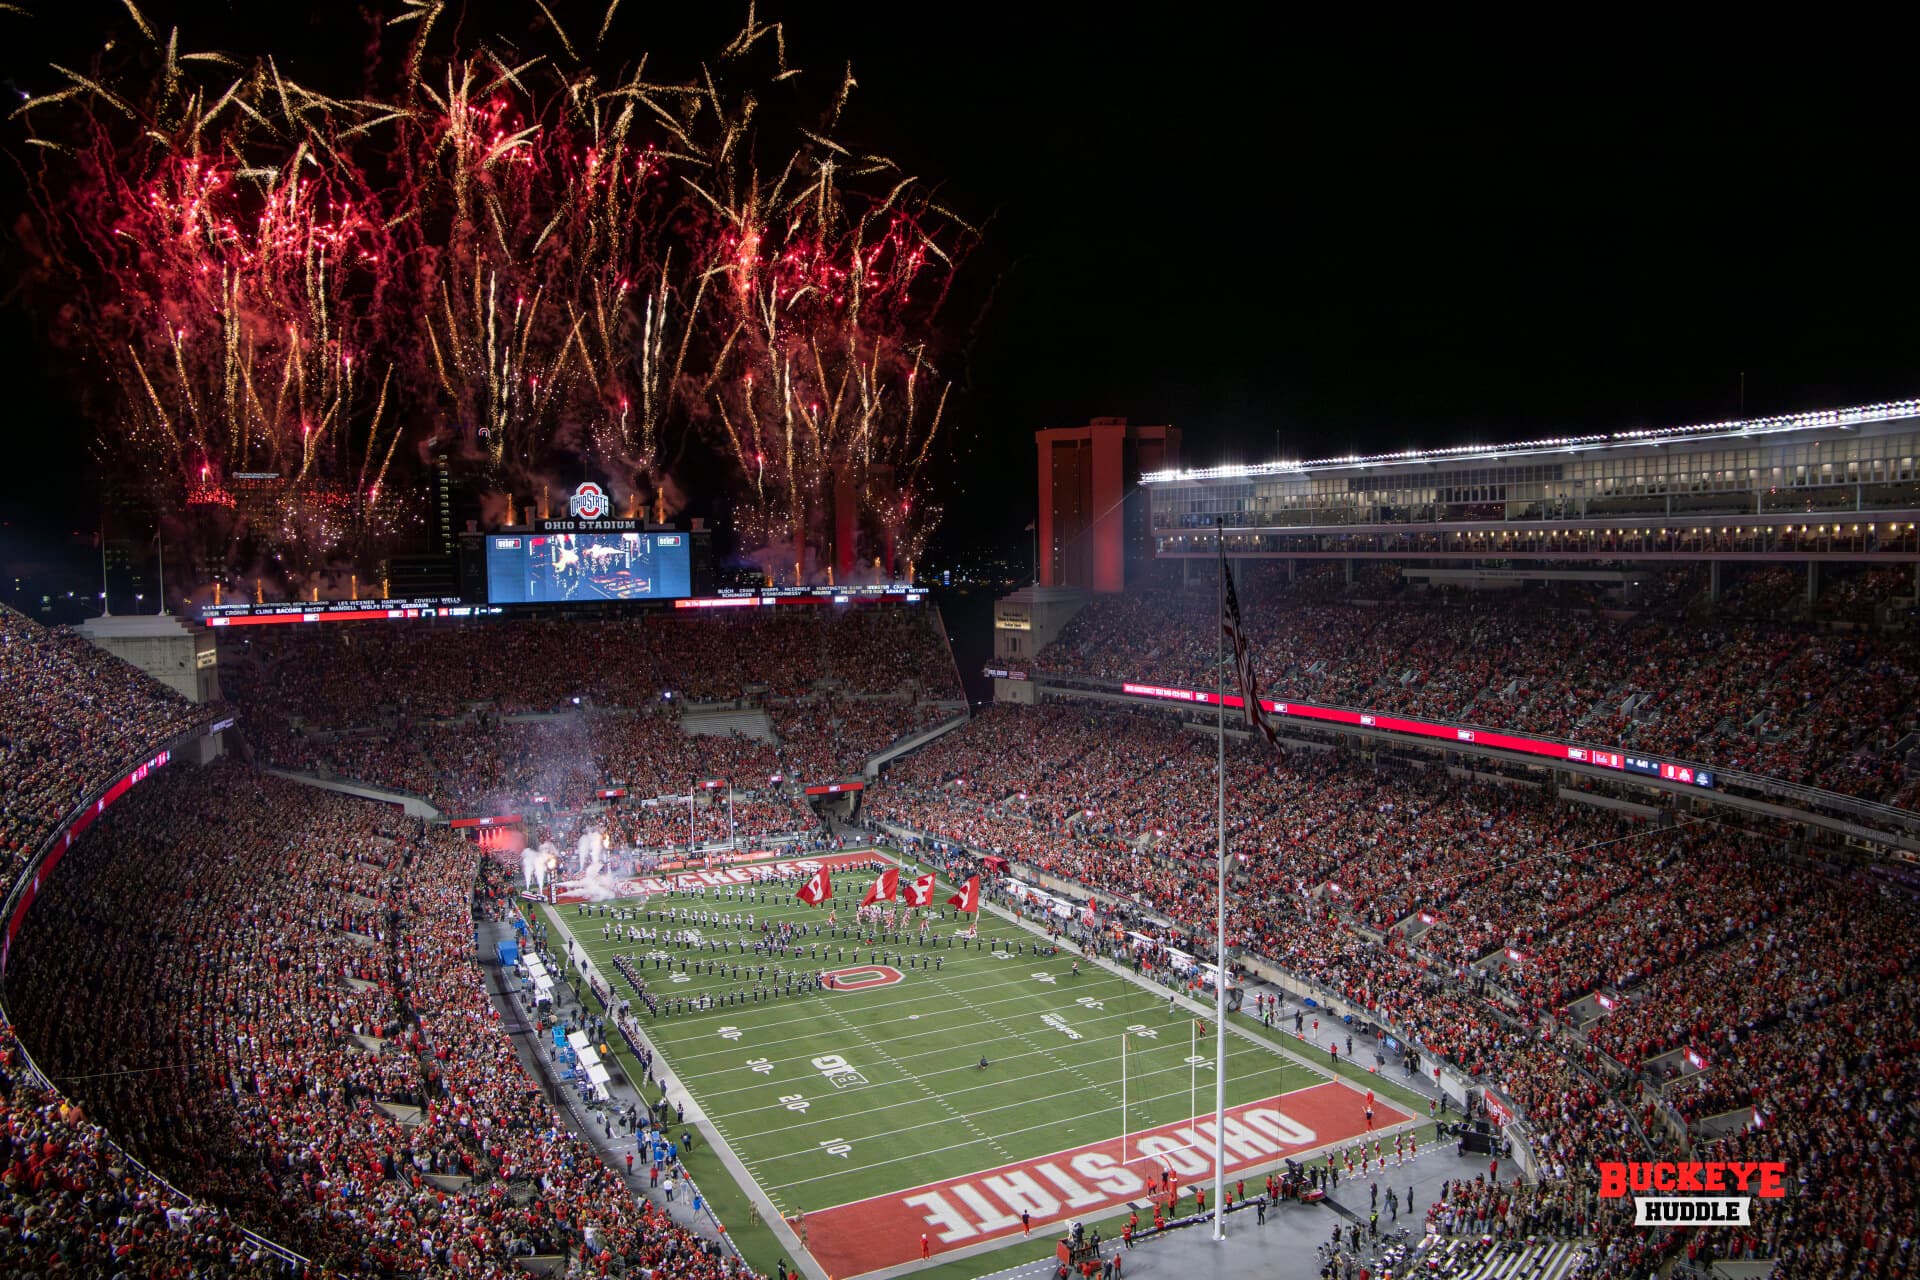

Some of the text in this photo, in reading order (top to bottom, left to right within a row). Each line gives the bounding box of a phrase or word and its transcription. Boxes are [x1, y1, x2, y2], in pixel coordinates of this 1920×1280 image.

[545, 520, 636, 530] OHIO STADIUM
[1126, 1024, 1159, 1039] 20
[746, 1057, 774, 1074] 30
[778, 1094, 810, 1112] 20
[819, 1138, 852, 1156] 10
[903, 1108, 1317, 1244] OHIO STATE
